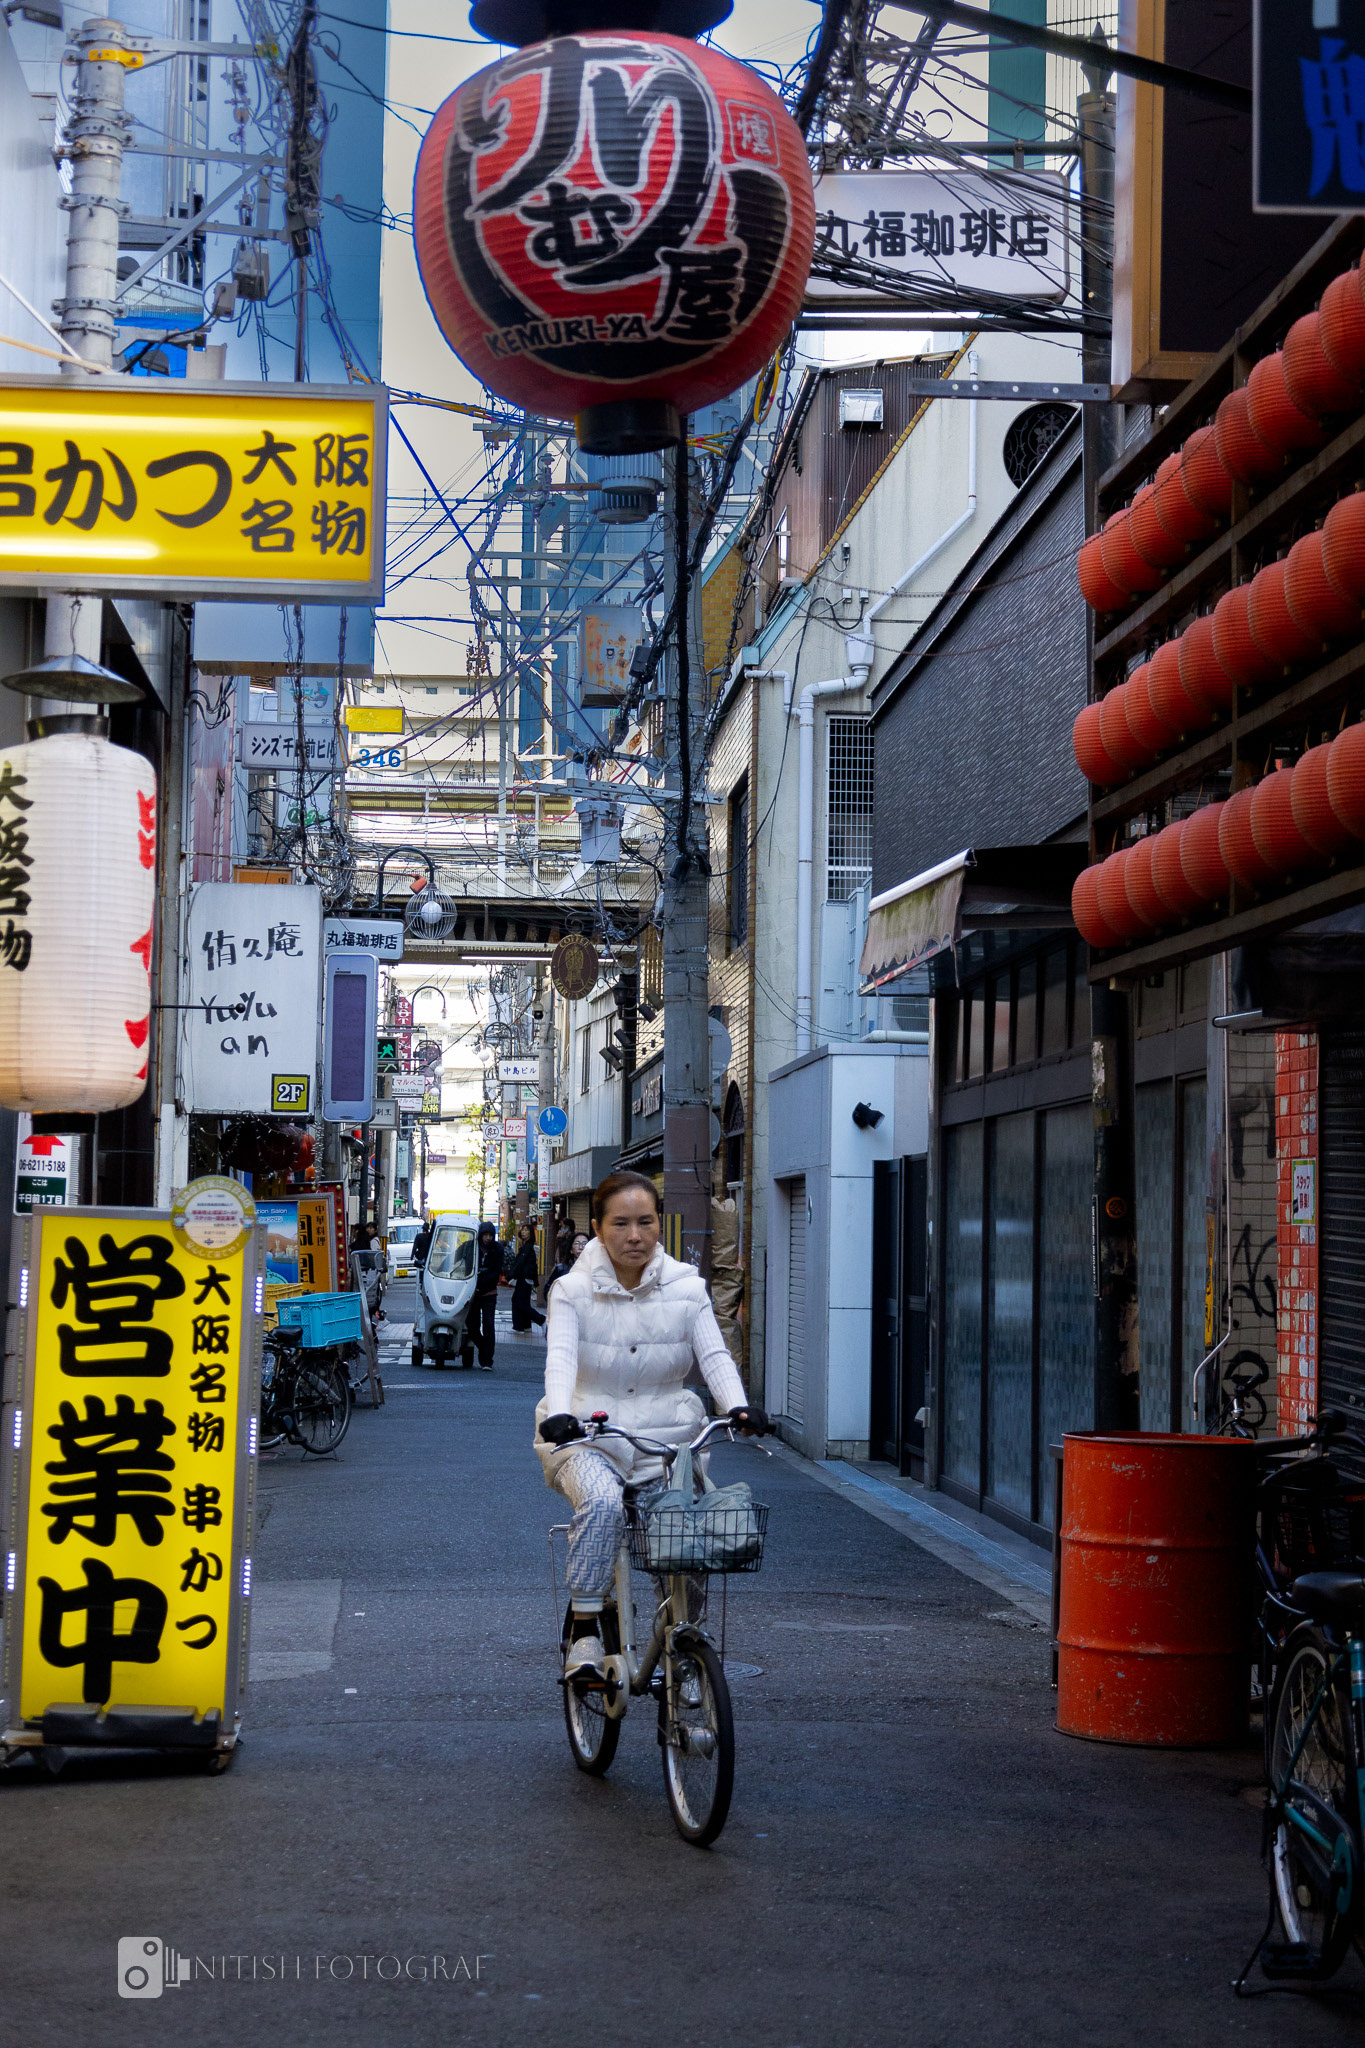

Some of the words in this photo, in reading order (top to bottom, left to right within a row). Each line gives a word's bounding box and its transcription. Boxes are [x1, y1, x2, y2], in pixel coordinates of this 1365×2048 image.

[814, 209, 1051, 259] 丸福珈琲店
[485, 318, 649, 358] KEMURI-YA
[241, 430, 370, 488] 大阪
[240, 498, 367, 556] 名物
[359, 748, 401, 768] 346
[327, 930, 398, 950] 丸福珈琲店
[559, 935, 591, 949] COFFEE
[220, 1034, 270, 1057] an
[503, 1066, 537, 1075] 中島ビル
[277, 1083, 304, 1102] 2F
[18, 1158, 66, 1173] 06-6211-5188
[31, 1178, 48, 1186] ここは
[1296, 1175, 1311, 1190] スタッフ
[18, 1193, 63, 1205] 千日前1丁目
[314, 1205, 327, 1247] 中華料理
[182, 1264, 232, 1453] 大阪名物
[38, 1233, 186, 1704] 営業中
[175, 1483, 224, 1650] 串かつ
